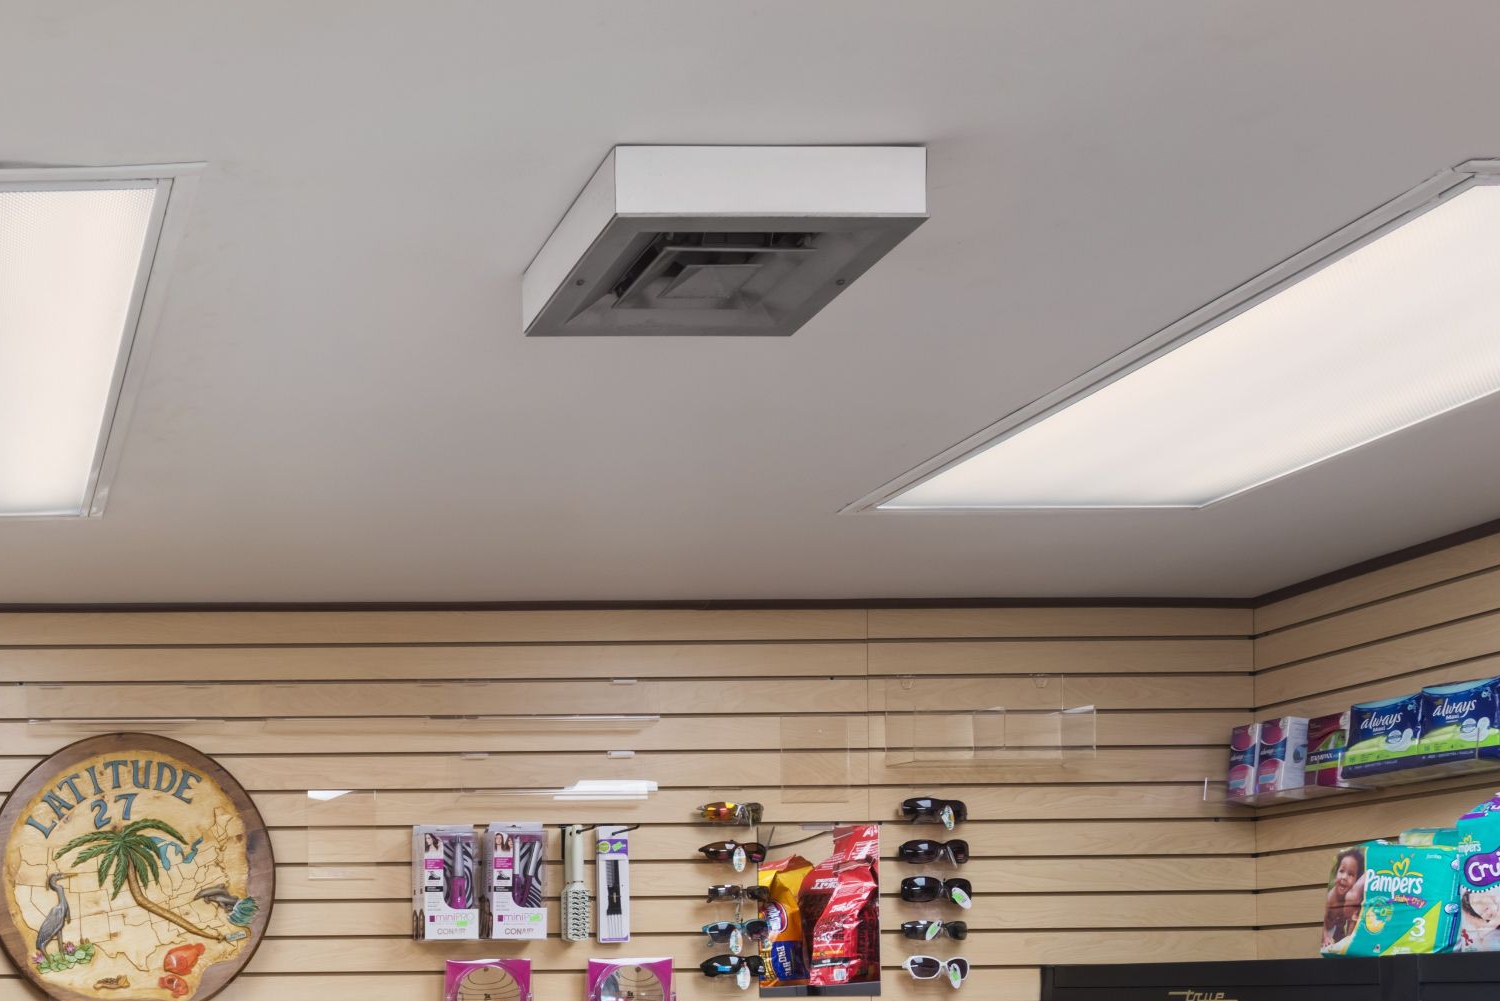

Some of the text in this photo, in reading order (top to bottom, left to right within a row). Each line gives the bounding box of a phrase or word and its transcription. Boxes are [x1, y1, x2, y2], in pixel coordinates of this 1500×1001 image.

[1432, 698, 1477, 719] always
[1360, 711, 1403, 731] always
[26, 759, 203, 839] LATITUDE
[90, 792, 138, 830] 27
[1364, 868, 1424, 899] Pampers
[437, 927, 466, 936] CONAIR
[504, 927, 534, 936] CONAIR
[1410, 917, 1426, 937] 3
